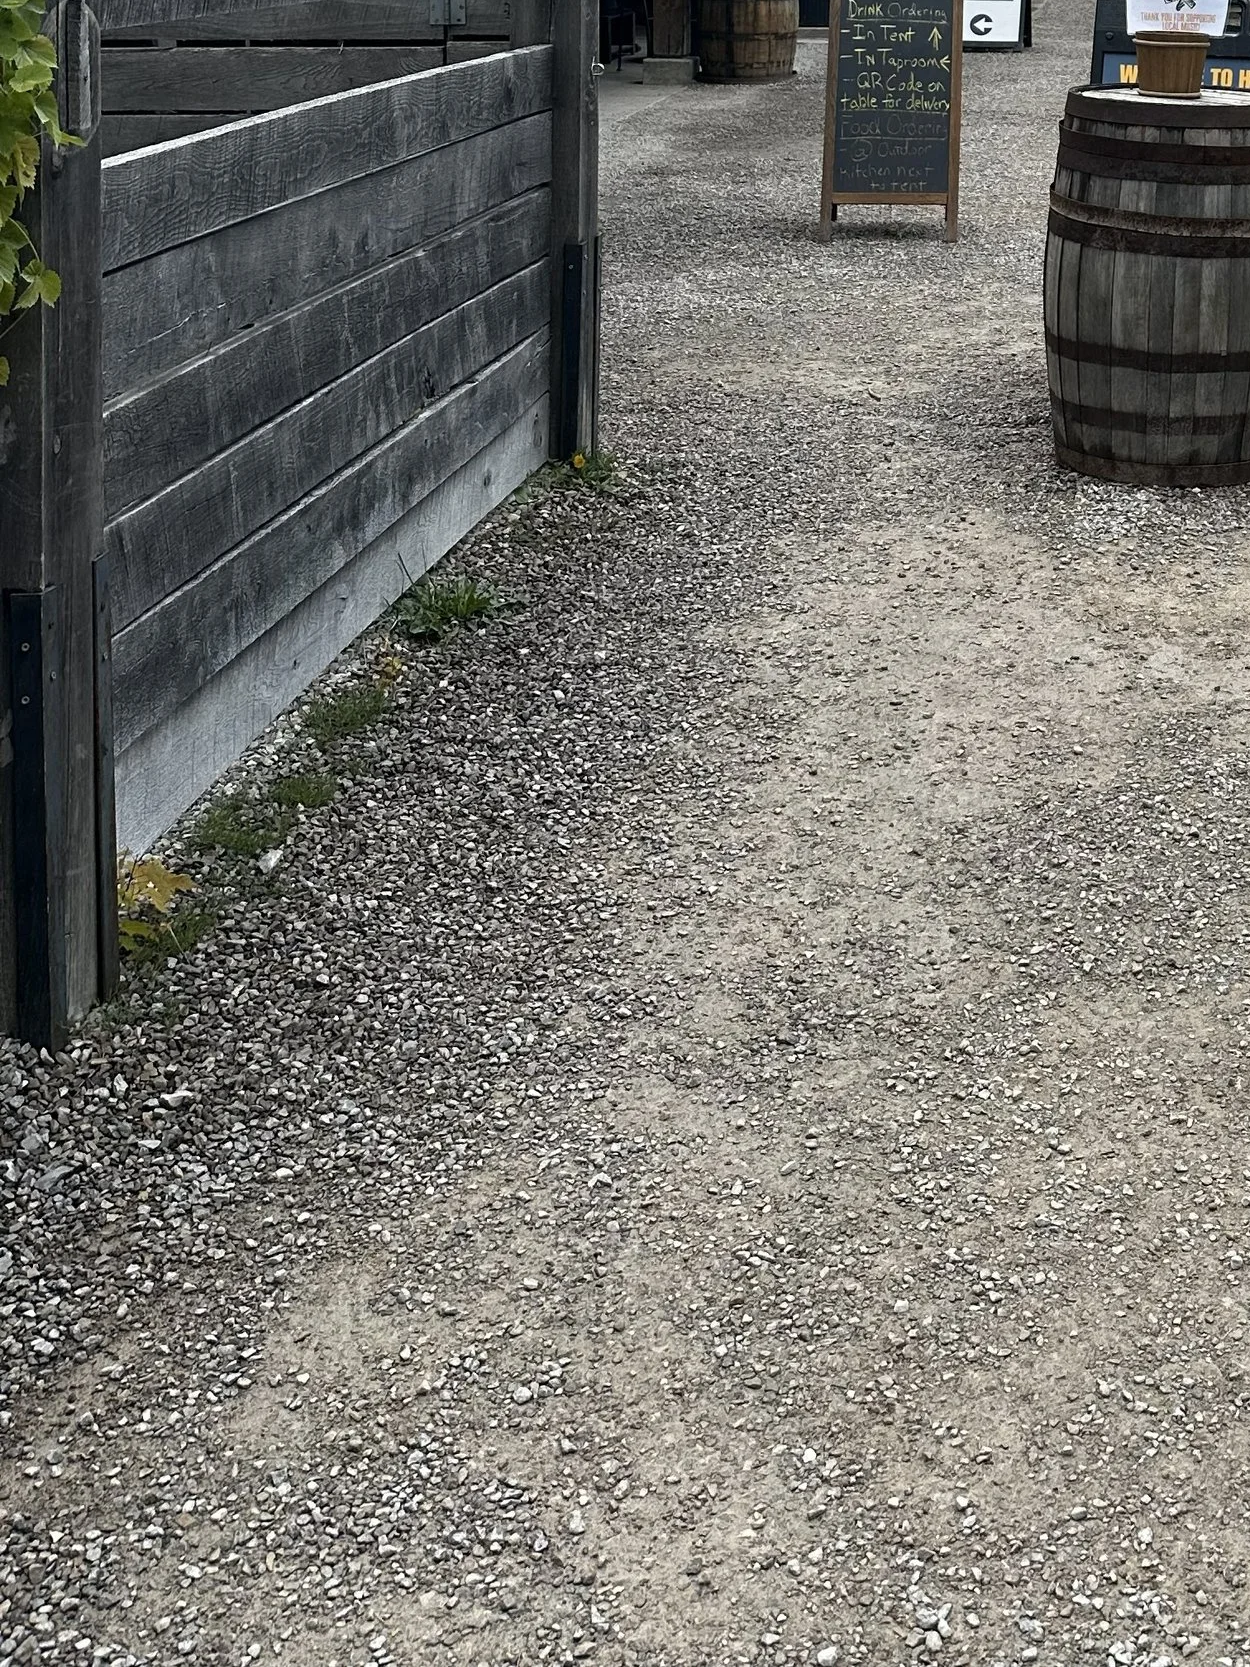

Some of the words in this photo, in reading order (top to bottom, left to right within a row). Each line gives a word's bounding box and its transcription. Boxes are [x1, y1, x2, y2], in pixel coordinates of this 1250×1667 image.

[887, 2, 948, 21] Ordering
[1141, 12, 1159, 22] THANK
[1161, 12, 1172, 23] YOU
[852, 24, 875, 41] In
[877, 48, 940, 73] Taproom
[857, 72, 883, 90] QR
[886, 71, 924, 93] Code
[928, 81, 946, 92] on
[1210, 68, 1233, 87] TO
[841, 93, 878, 112] table
[882, 94, 901, 108] for
[906, 93, 950, 111] delivery
[841, 114, 881, 139] Food
